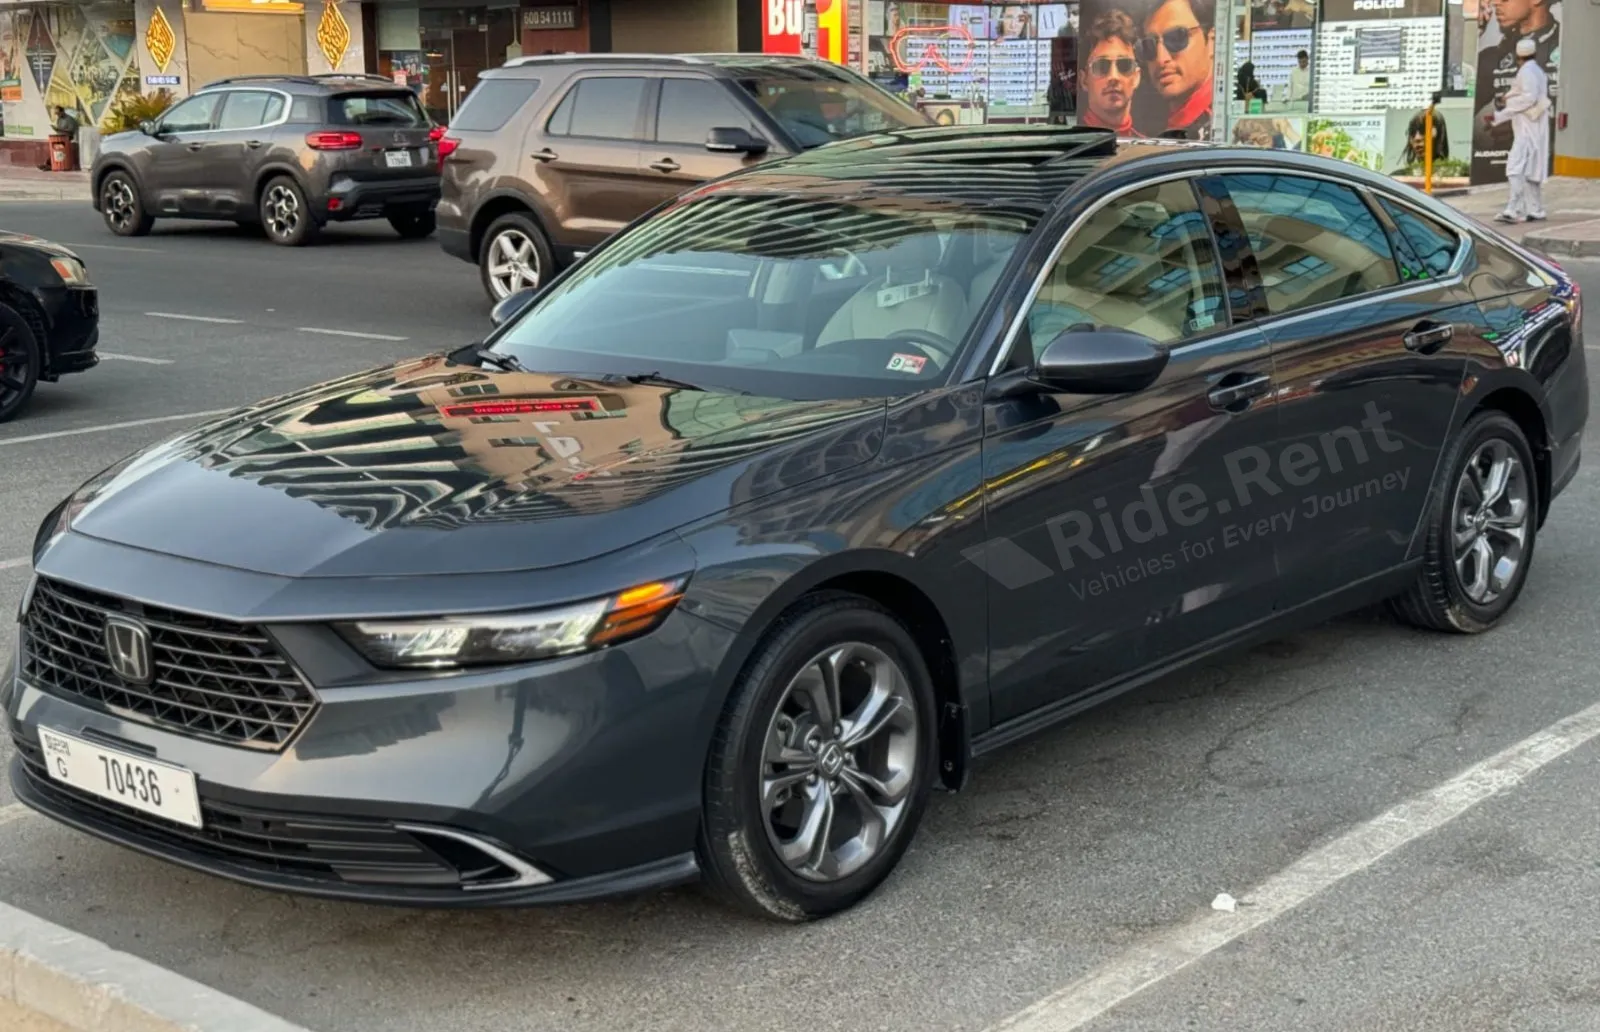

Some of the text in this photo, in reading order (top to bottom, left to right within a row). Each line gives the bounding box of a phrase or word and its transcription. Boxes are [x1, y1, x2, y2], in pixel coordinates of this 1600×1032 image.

[1353, 0, 1405, 10] POLICE
[57, 757, 68, 778] G
[98, 755, 162, 806] 70436
